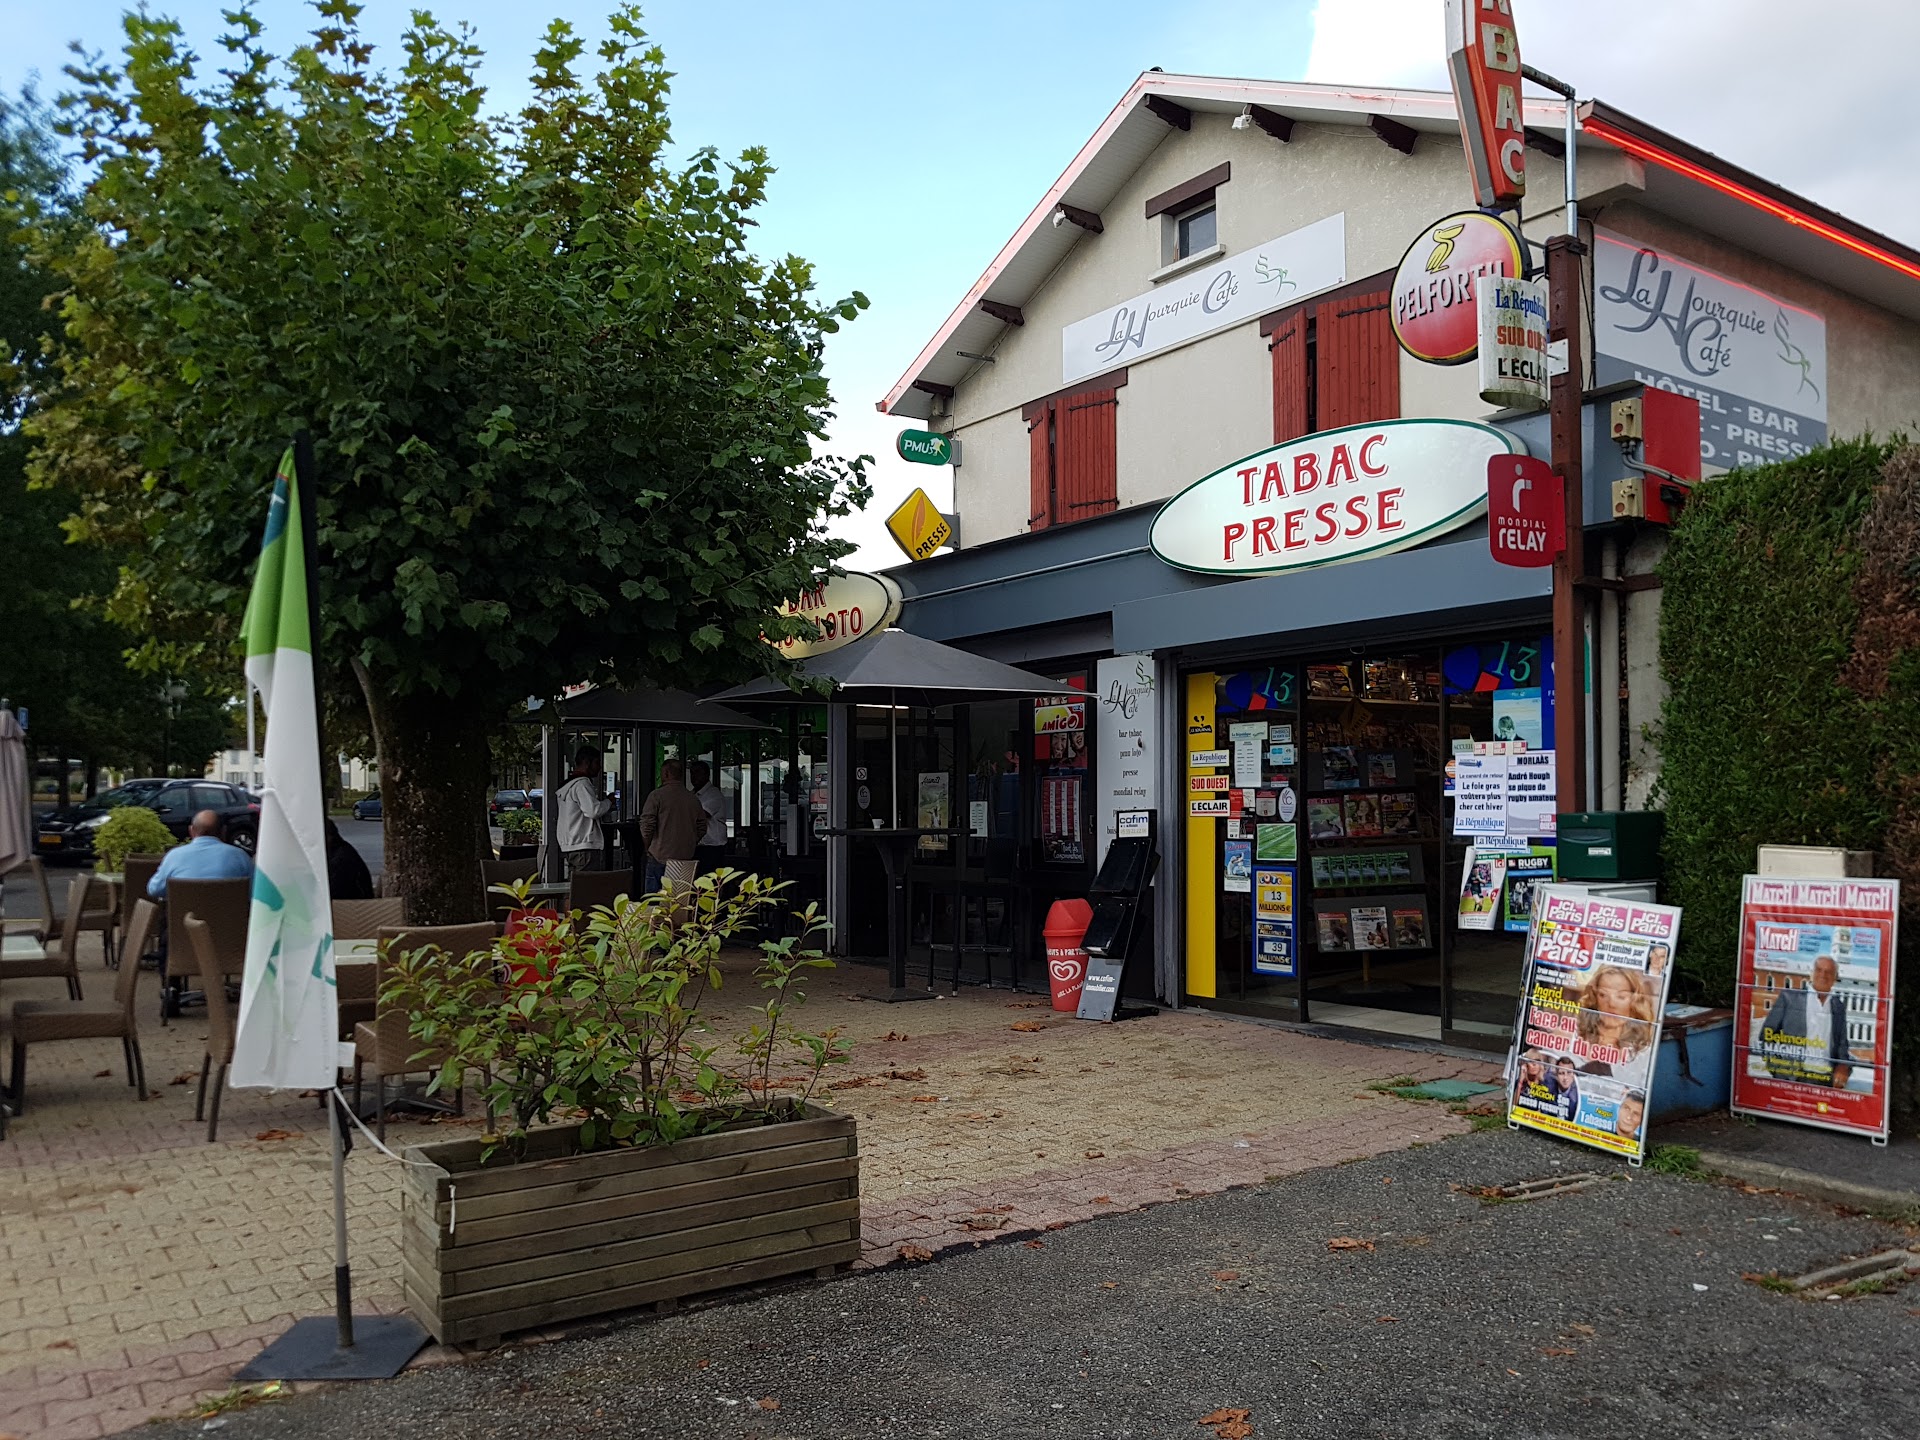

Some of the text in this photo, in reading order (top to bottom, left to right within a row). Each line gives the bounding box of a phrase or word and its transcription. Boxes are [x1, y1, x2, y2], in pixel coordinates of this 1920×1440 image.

[1495, 289, 1508, 308] La
[1095, 270, 1240, 363] La Hourquie Café
[1613, 270, 1765, 346] Hourquie
[1497, 326, 1525, 347] SUD
[1680, 316, 1732, 376] Café
[1748, 406, 1799, 436] BAR
[904, 439, 930, 454] PMU
[1726, 423, 1812, 457] PRESS
[1237, 434, 1389, 506] TABAC
[1223, 487, 1406, 562] PRESSE
[915, 522, 947, 558] PRESSE
[1492, 641, 1537, 682] 13
[1261, 667, 1295, 702] 13
[1118, 729, 1142, 738] bar tabac
[1200, 752, 1227, 763] République
[1122, 769, 1138, 778] presse
[1508, 772, 1527, 780] André
[1113, 787, 1146, 797] mondial relay
[1191, 777, 1227, 789] SUD OUEST
[1462, 782, 1500, 792] Le foie gras
[1460, 792, 1501, 801] coûtera plus
[1459, 802, 1503, 810] cher cet hiver
[1455, 817, 1505, 829] La République
[1475, 836, 1526, 847] La République
[1518, 858, 1549, 868] RUGBY
[1271, 890, 1282, 900] 13
[1258, 904, 1285, 912] MILLIONS
[1548, 905, 1669, 936] Paris Paris Paris
[1271, 942, 1283, 952] 39
[1760, 927, 1798, 951] MATCH
[1258, 954, 1285, 963] MILLIONS
[1537, 936, 1590, 966] Paris
[1533, 982, 1564, 999] Ingrid
[1531, 993, 1581, 1014] CHAUVIN
[1528, 1007, 1577, 1033] Face au
[1526, 1028, 1570, 1051] cancer
[1573, 1036, 1589, 1057] du
[1591, 1045, 1620, 1065] sein
[1764, 1027, 1827, 1049] Belmondo
[1530, 1088, 1555, 1101] MACRON
